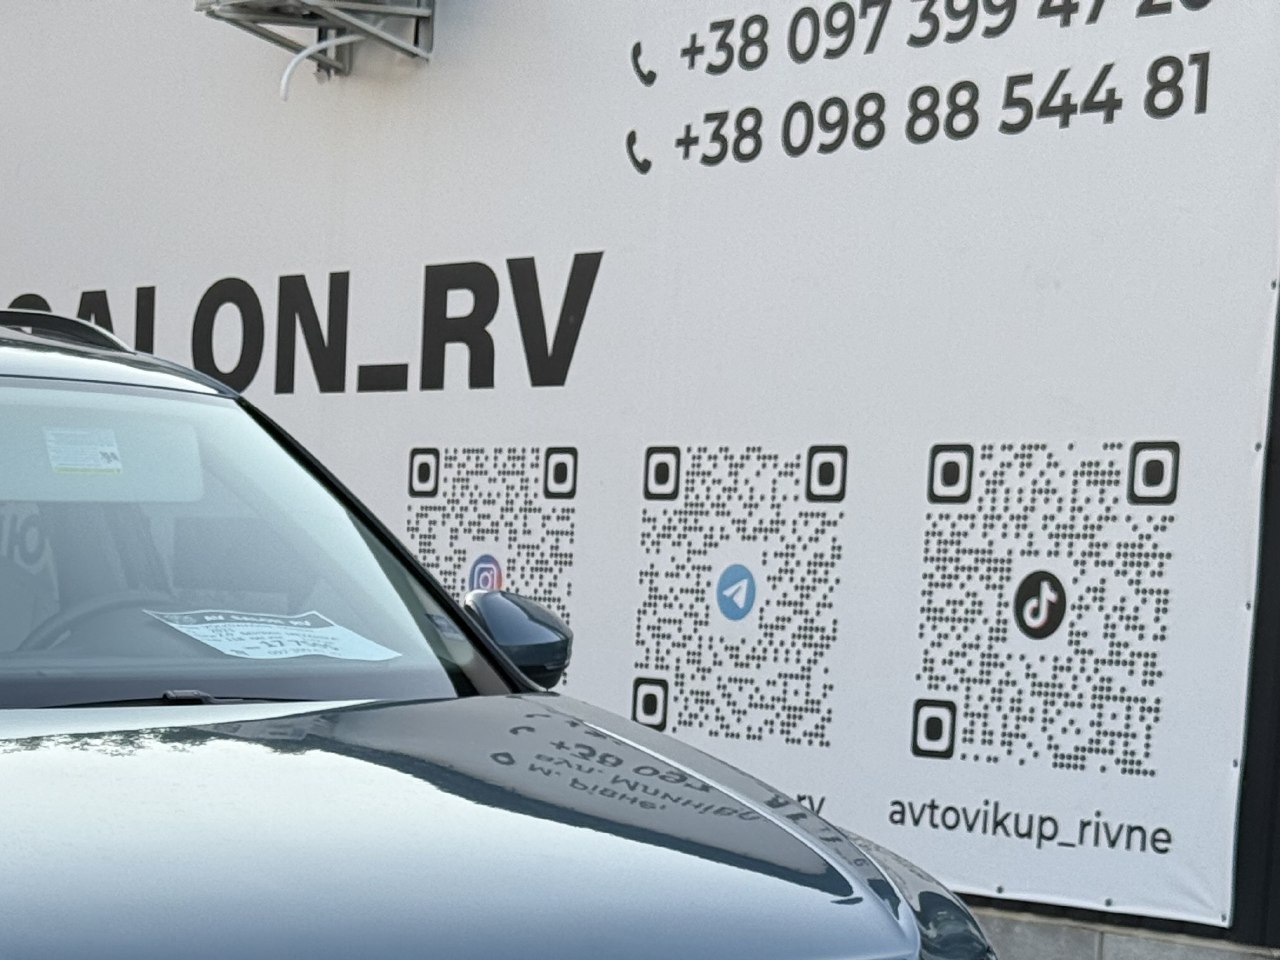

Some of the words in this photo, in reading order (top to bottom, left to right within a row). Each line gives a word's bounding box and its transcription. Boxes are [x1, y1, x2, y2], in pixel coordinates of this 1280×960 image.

[680, 14, 769, 76] +38
[787, 0, 893, 65] 097
[906, 0, 1018, 48] 399
[675, 106, 763, 167] +38
[781, 92, 886, 158] 098
[905, 80, 980, 145] 88
[998, 62, 1123, 135] 544
[1143, 51, 1210, 120] 81
[7, 251, 604, 395] ON_RV
[888, 798, 1173, 854] avtovikup_rivne
